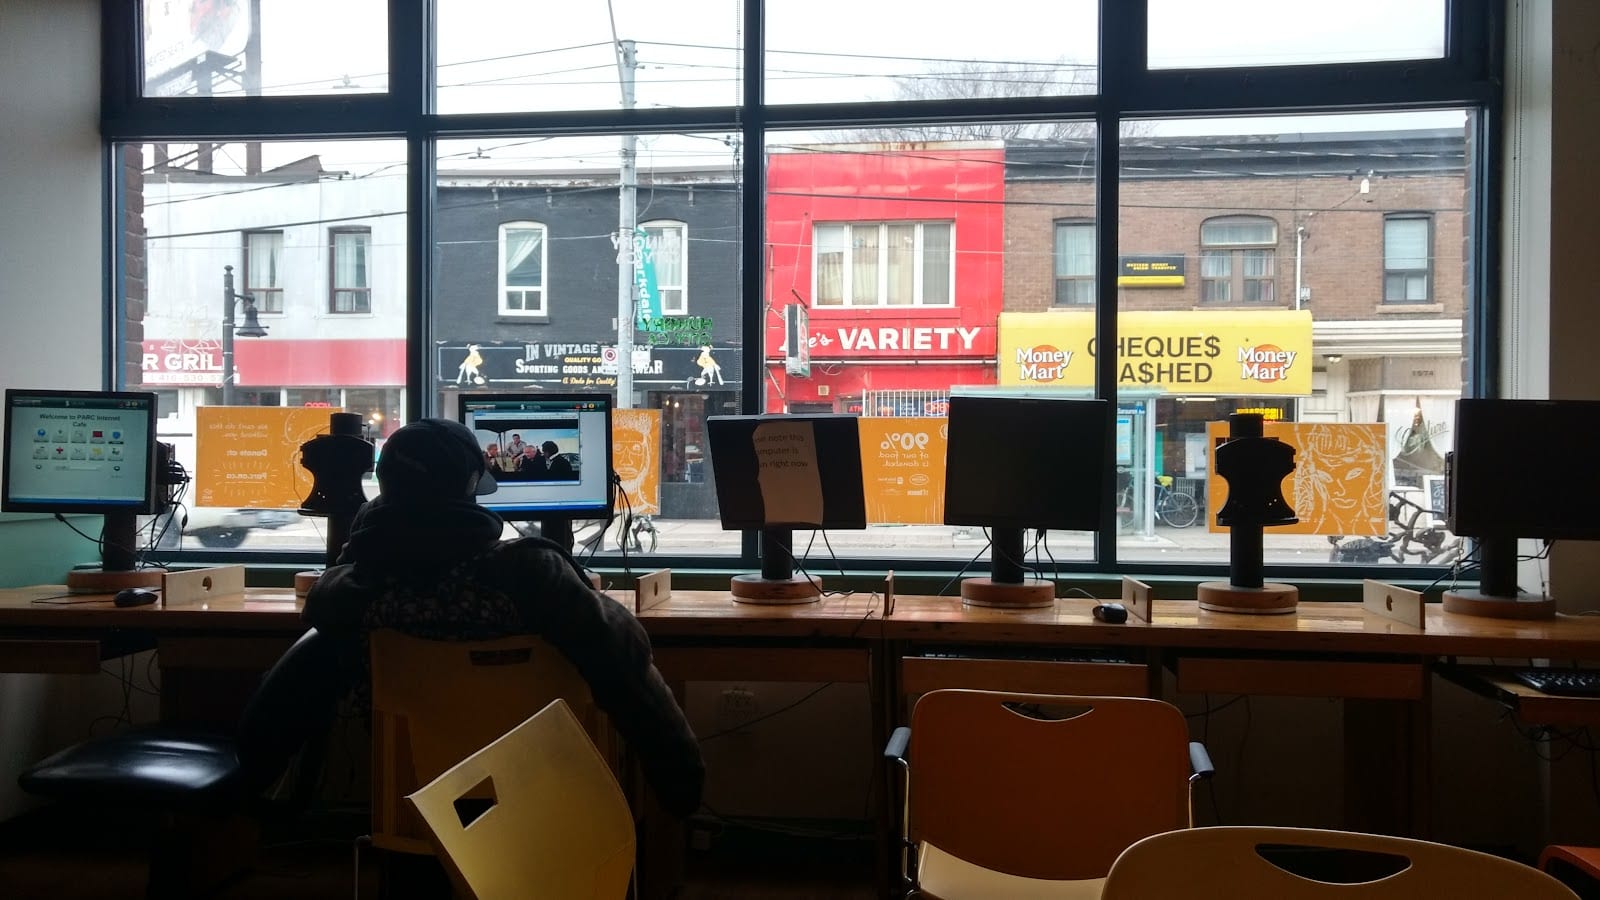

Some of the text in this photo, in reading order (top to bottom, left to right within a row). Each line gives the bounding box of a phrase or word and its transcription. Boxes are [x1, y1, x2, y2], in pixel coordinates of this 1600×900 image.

[837, 327, 981, 350] VARIETY
[525, 344, 540, 362] IN
[544, 344, 598, 359] VINTAGE
[1016, 347, 1074, 368] Money
[1237, 347, 1297, 368] Money
[562, 365, 588, 374] GOODS
[1019, 363, 1064, 381] Mart
[1119, 362, 1213, 384] A$HED
[1241, 363, 1288, 381] Mart
[768, 434, 788, 442] note
[789, 433, 804, 442] this
[769, 459, 790, 469] right
